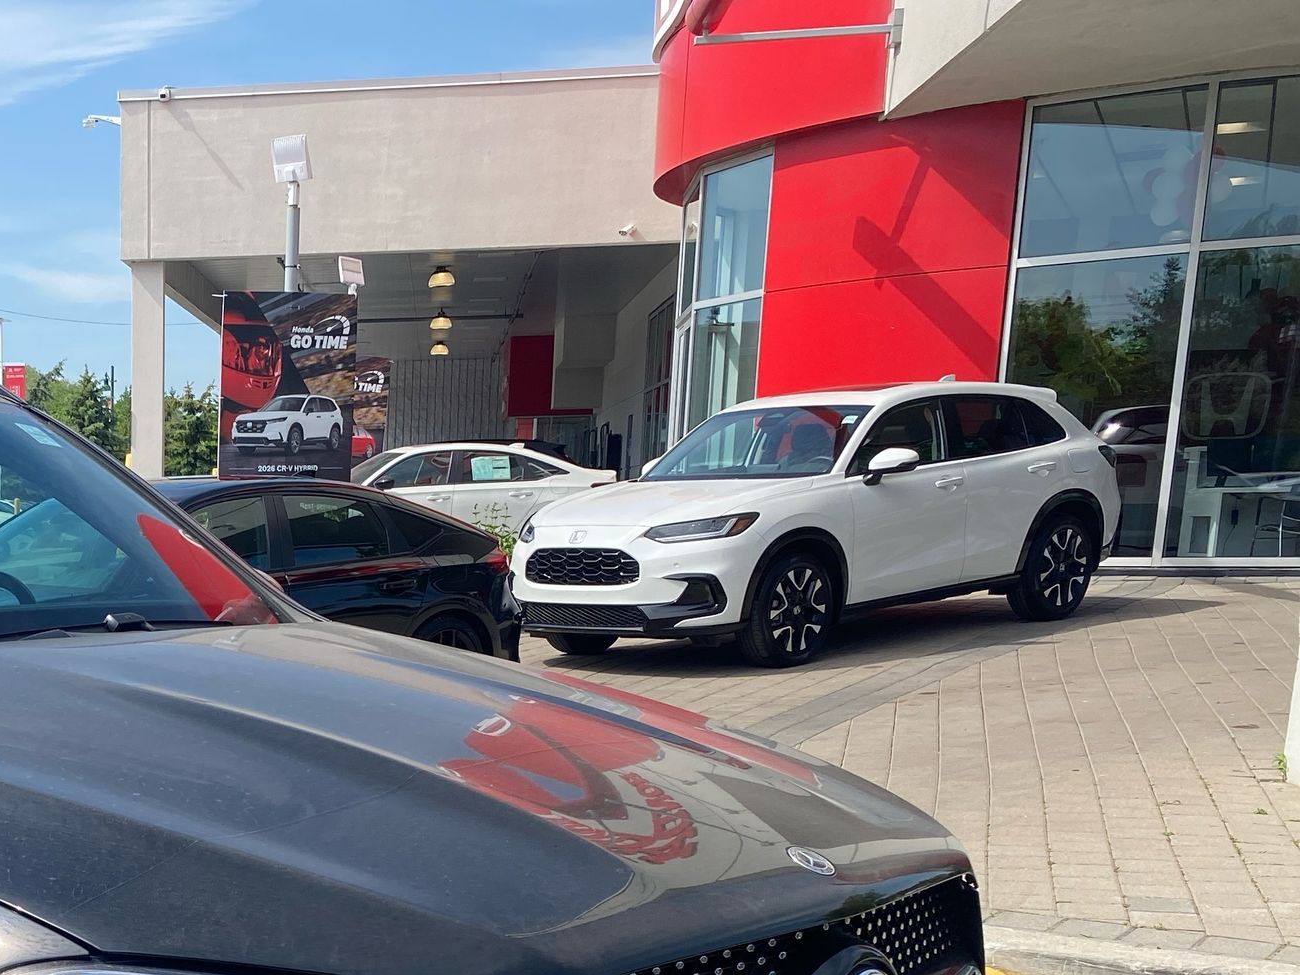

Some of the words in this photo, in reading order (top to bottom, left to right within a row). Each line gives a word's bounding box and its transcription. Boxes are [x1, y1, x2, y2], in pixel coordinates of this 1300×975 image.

[291, 325, 314, 334] Honda
[290, 334, 313, 349] GO
[314, 335, 349, 350] TIME
[358, 382, 383, 393] TIME
[257, 464, 276, 473] 2026
[276, 464, 294, 472] CR-V
[294, 464, 319, 472] HYBRID
